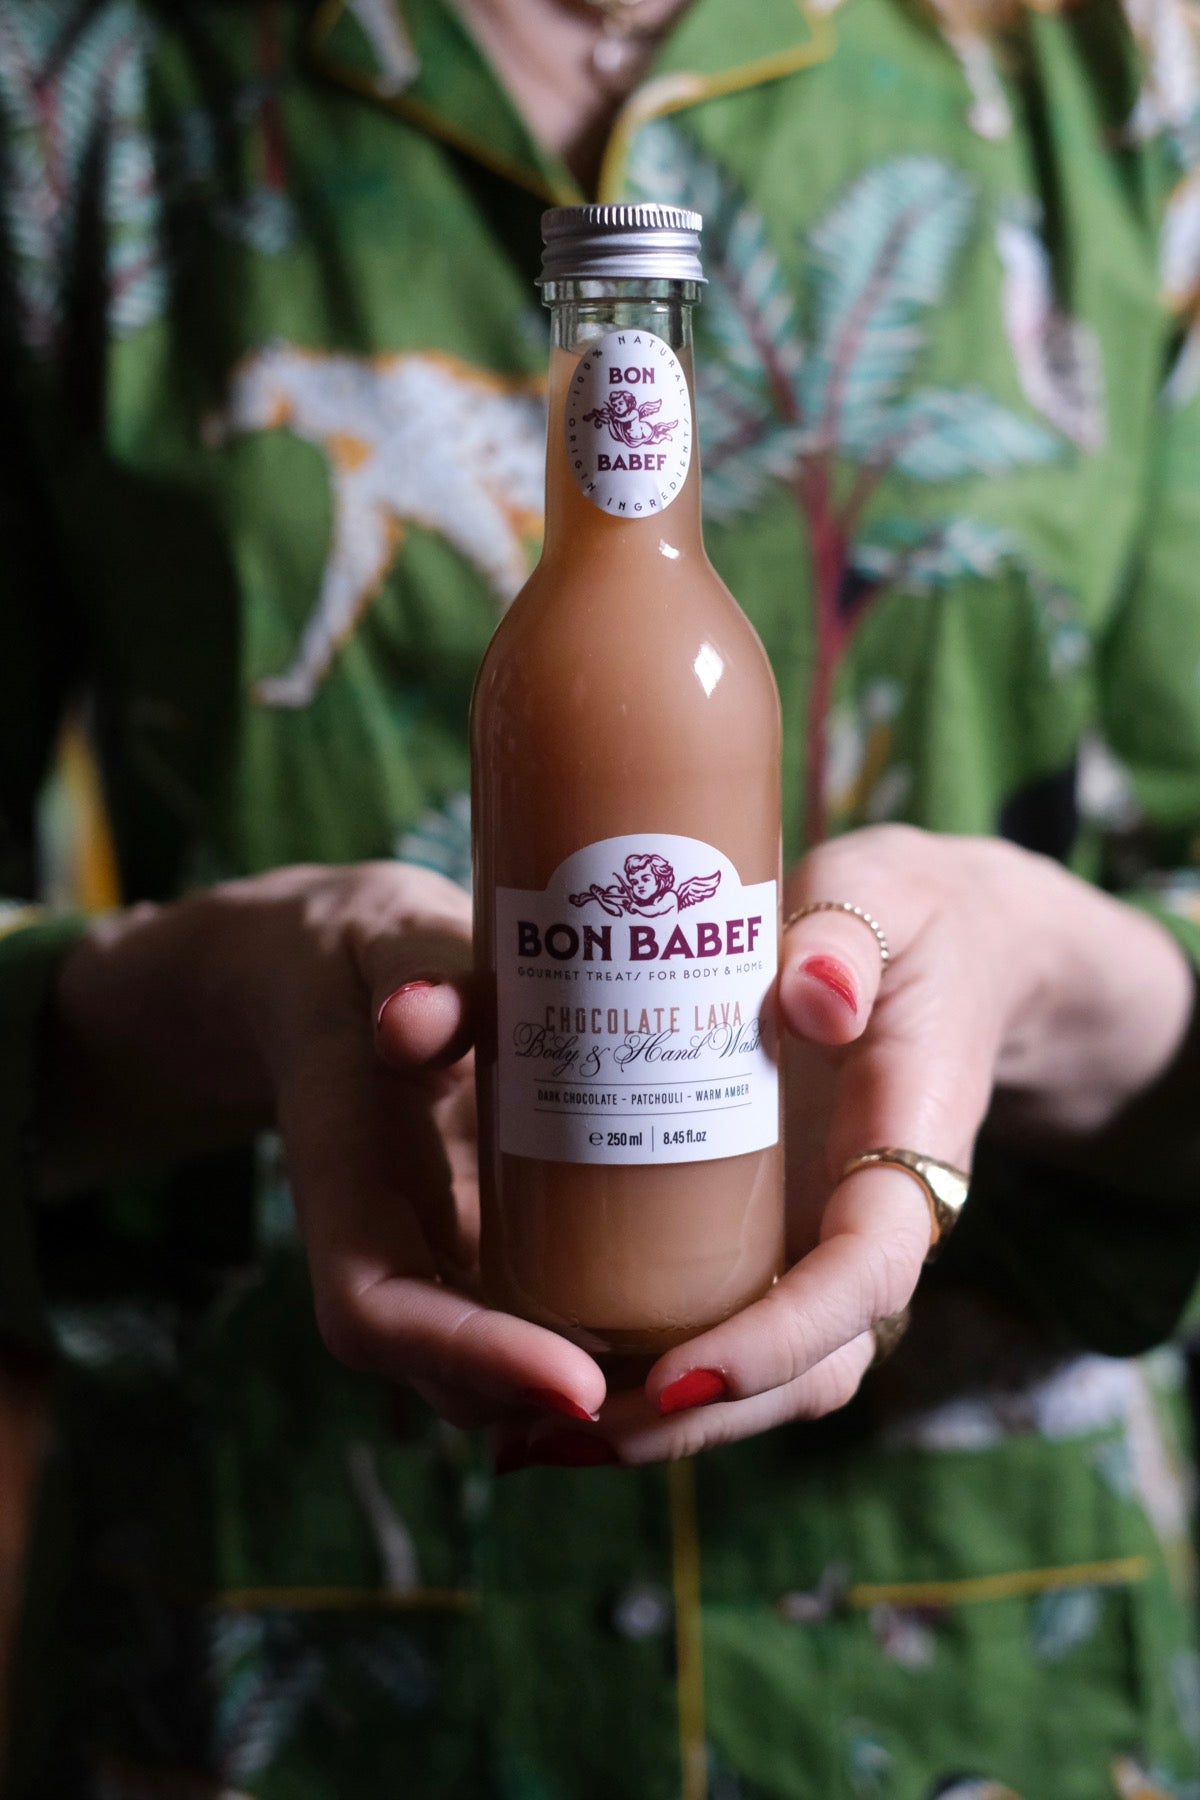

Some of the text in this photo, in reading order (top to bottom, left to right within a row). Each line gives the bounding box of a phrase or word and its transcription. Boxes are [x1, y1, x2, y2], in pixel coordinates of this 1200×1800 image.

[609, 367, 655, 384] BON
[618, 336, 685, 395] NATURAL
[569, 418, 596, 491] ORIGIN
[598, 454, 667, 471] BABEF
[517, 915, 762, 961] BON BABEF
[518, 966, 579, 981] GOURMET
[649, 971, 676, 981] FOR
[683, 968, 718, 980] BODY
[724, 966, 731, 975] &
[736, 961, 763, 974] HOME
[545, 1001, 742, 1035] CHOCOLATE LAVA
[513, 1017, 764, 1078] Body & Hand Wash
[538, 1090, 561, 1103] DARK
[563, 1091, 618, 1105] CHOCOLATE
[631, 1092, 683, 1105] PATCHOULI
[695, 1090, 722, 1102] WARM
[725, 1084, 750, 1097] AMBER
[607, 1132, 627, 1146] 250
[629, 1132, 642, 1146] ml
[663, 1130, 706, 1145] 8.45 fl.oz
